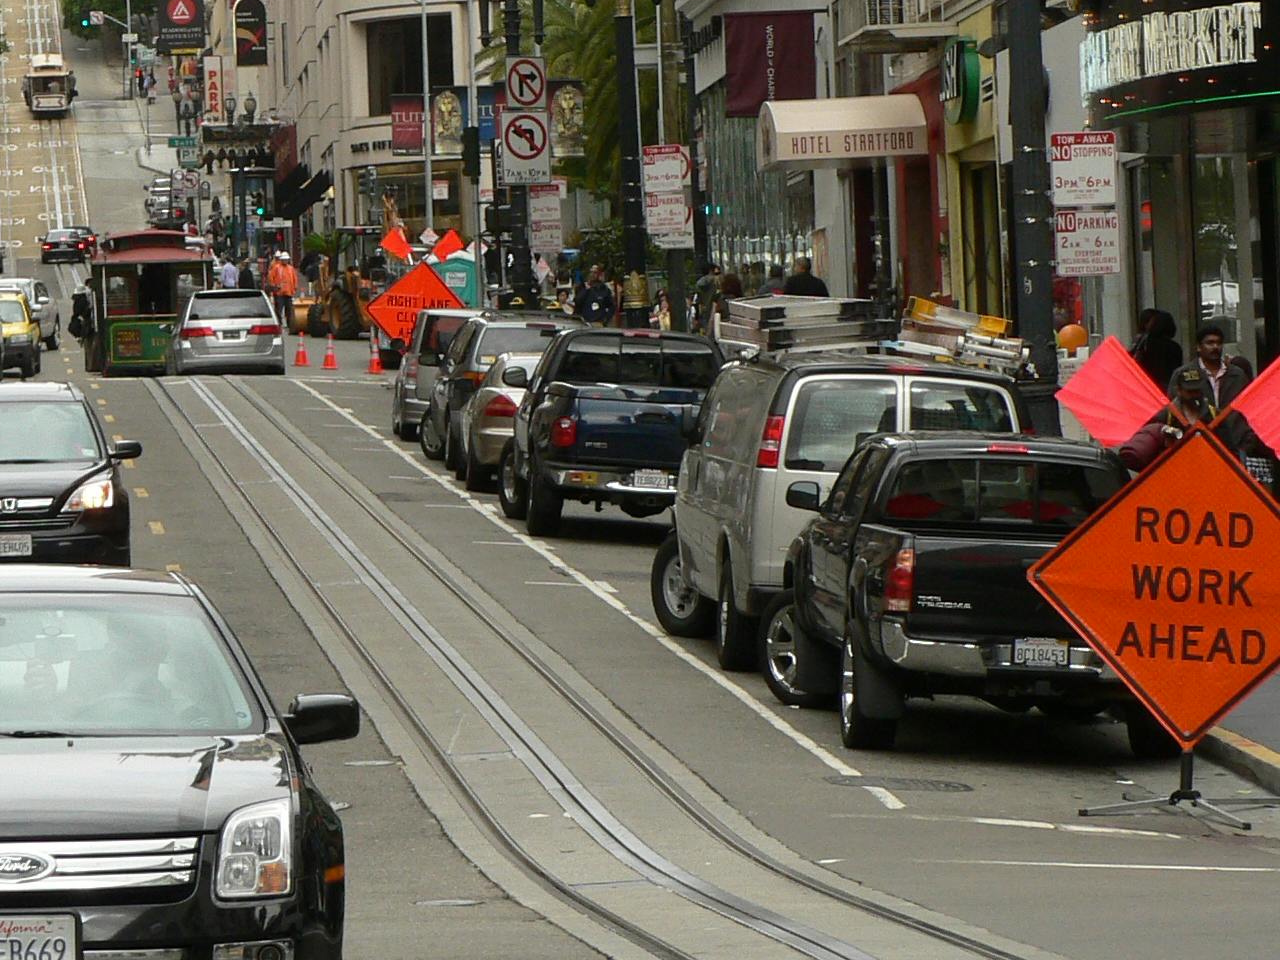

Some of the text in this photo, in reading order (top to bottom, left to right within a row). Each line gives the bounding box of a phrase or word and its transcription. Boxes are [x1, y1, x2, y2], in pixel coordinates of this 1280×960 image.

[765, 24, 775, 58] WORLD
[1142, 2, 1262, 78] MARKET
[791, 136, 832, 154] HOTEL
[1052, 145, 1113, 160] NO STOPPING
[1058, 214, 1118, 231] NO PARKING
[386, 294, 451, 309] RIGHT LANE
[396, 311, 417, 324] CLO
[1135, 506, 1254, 550] ROAD
[1132, 563, 1253, 607] WORK
[1115, 621, 1266, 666] AHEAD
